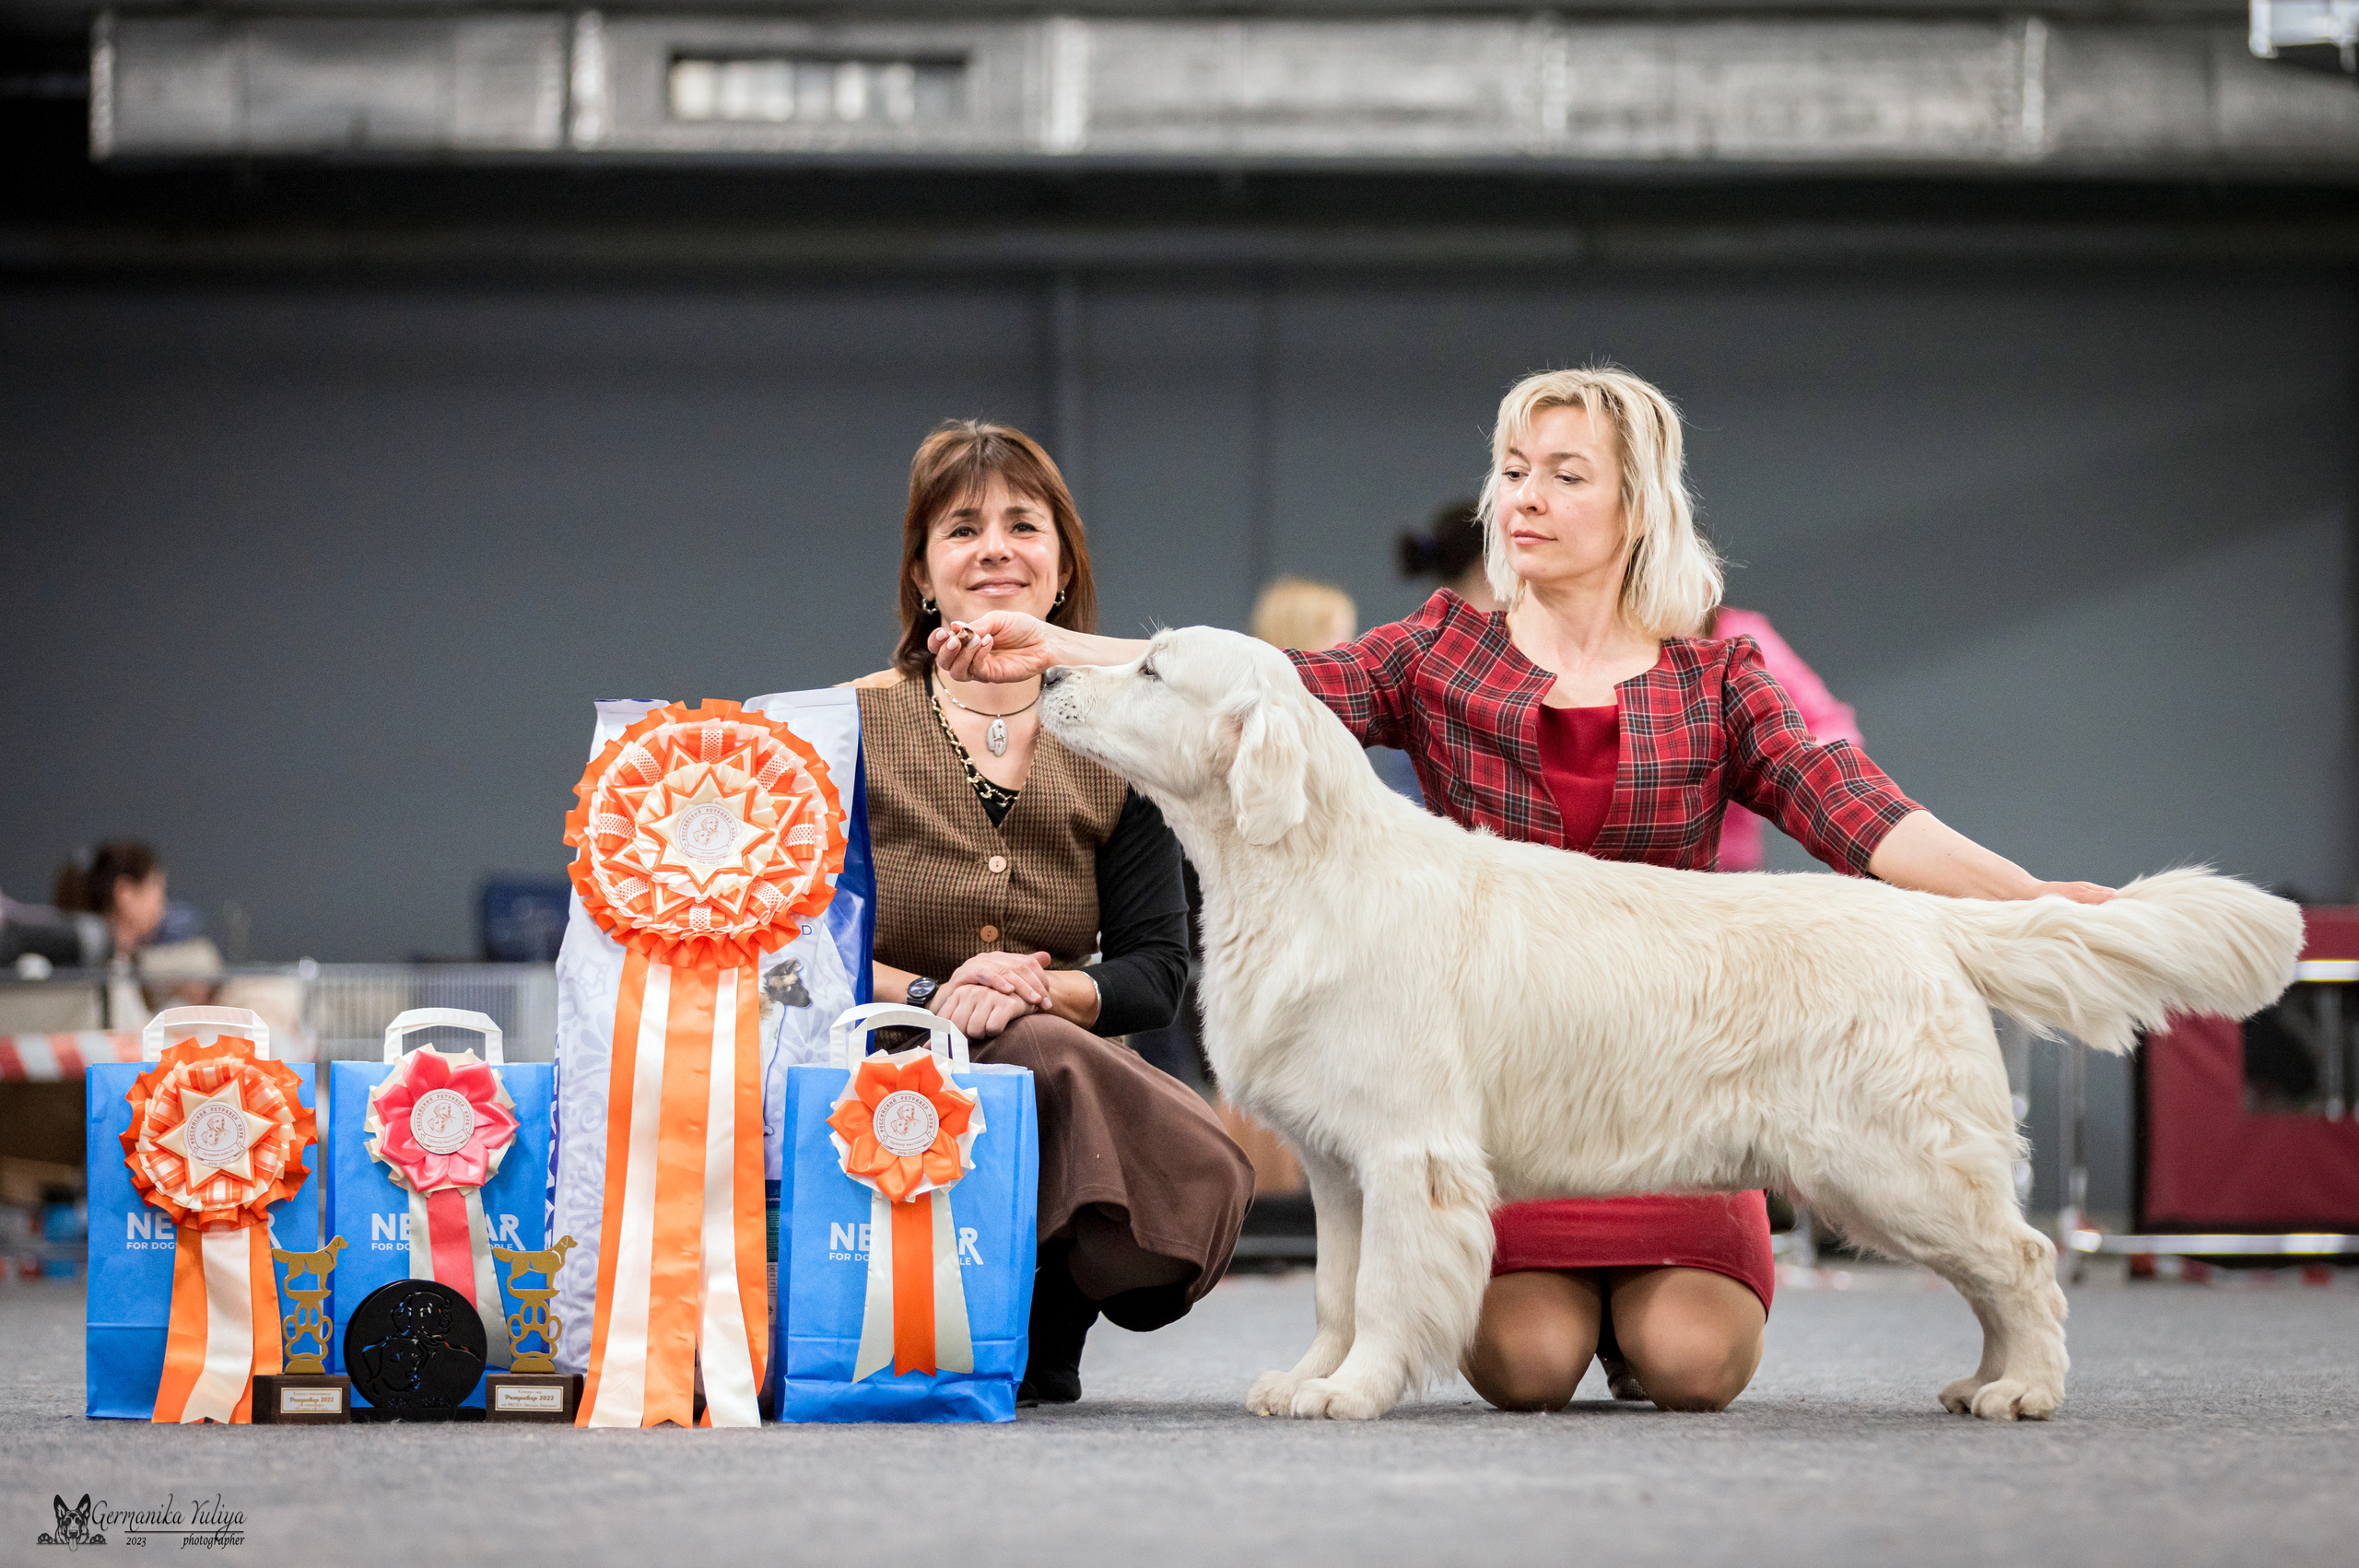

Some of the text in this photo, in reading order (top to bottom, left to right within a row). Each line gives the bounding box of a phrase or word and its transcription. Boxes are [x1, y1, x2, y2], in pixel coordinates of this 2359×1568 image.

[416, 1096, 433, 1131] РОССИЙСКИЙ
[437, 1094, 464, 1107] РЕТРИВЕР
[878, 1097, 898, 1133] РОССИЙСКИЙ
[900, 1095, 929, 1110] РЕТРИВЕР
[126, 1242, 176, 1250] FOR DOG
[371, 1243, 393, 1251] FOR
[829, 1252, 851, 1261] FOR
[288, 1396, 320, 1406] Ретривер
[504, 1394, 538, 1403] Ретривер
